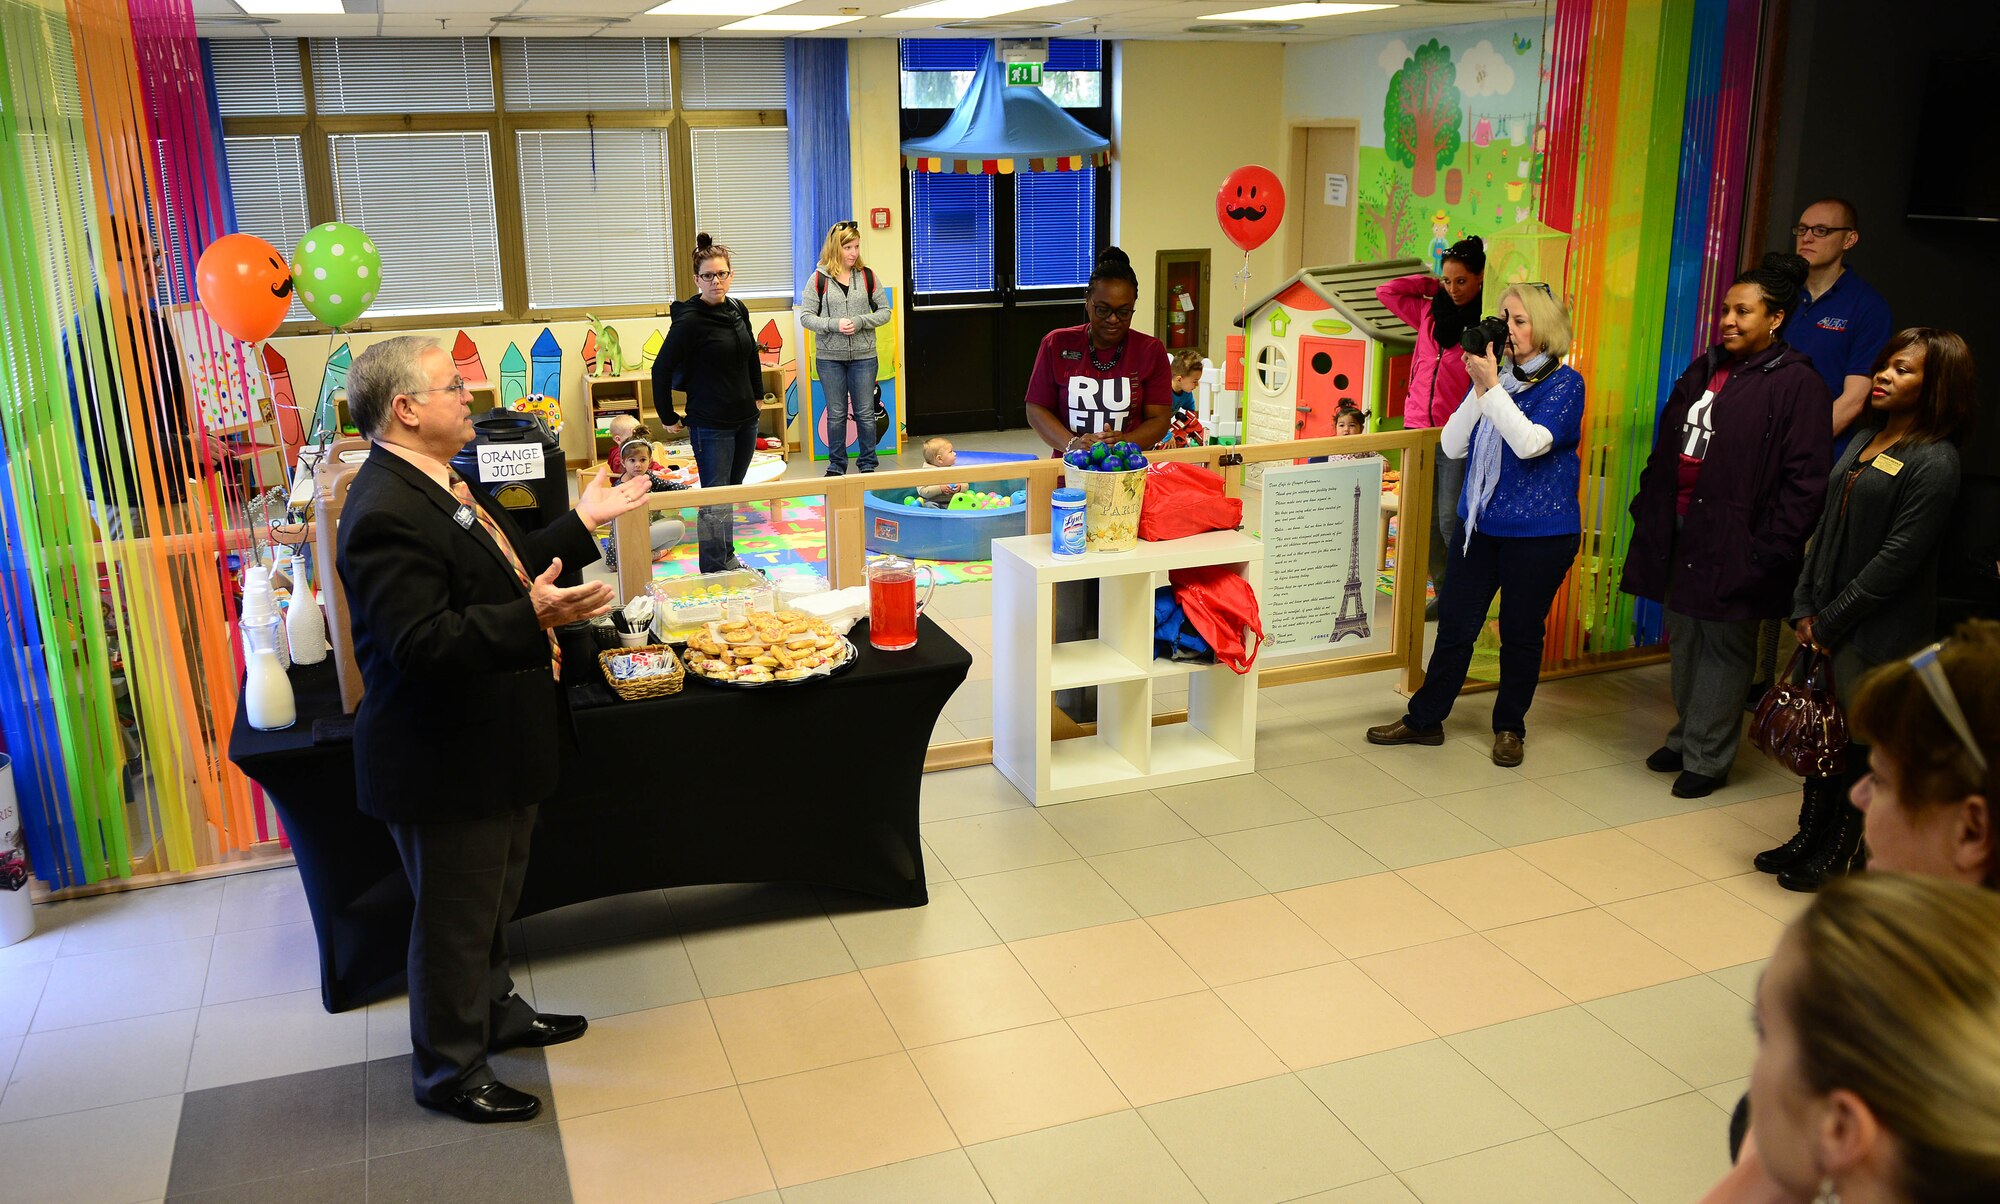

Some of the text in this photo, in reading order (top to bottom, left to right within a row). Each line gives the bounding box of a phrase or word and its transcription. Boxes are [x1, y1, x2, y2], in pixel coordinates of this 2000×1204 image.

[1068, 375, 1131, 411] RU
[1068, 408, 1130, 434] FIT
[481, 448, 540, 464] ORANGE
[492, 463, 533, 478] JUICE
[1065, 512, 1083, 526] Lysol
